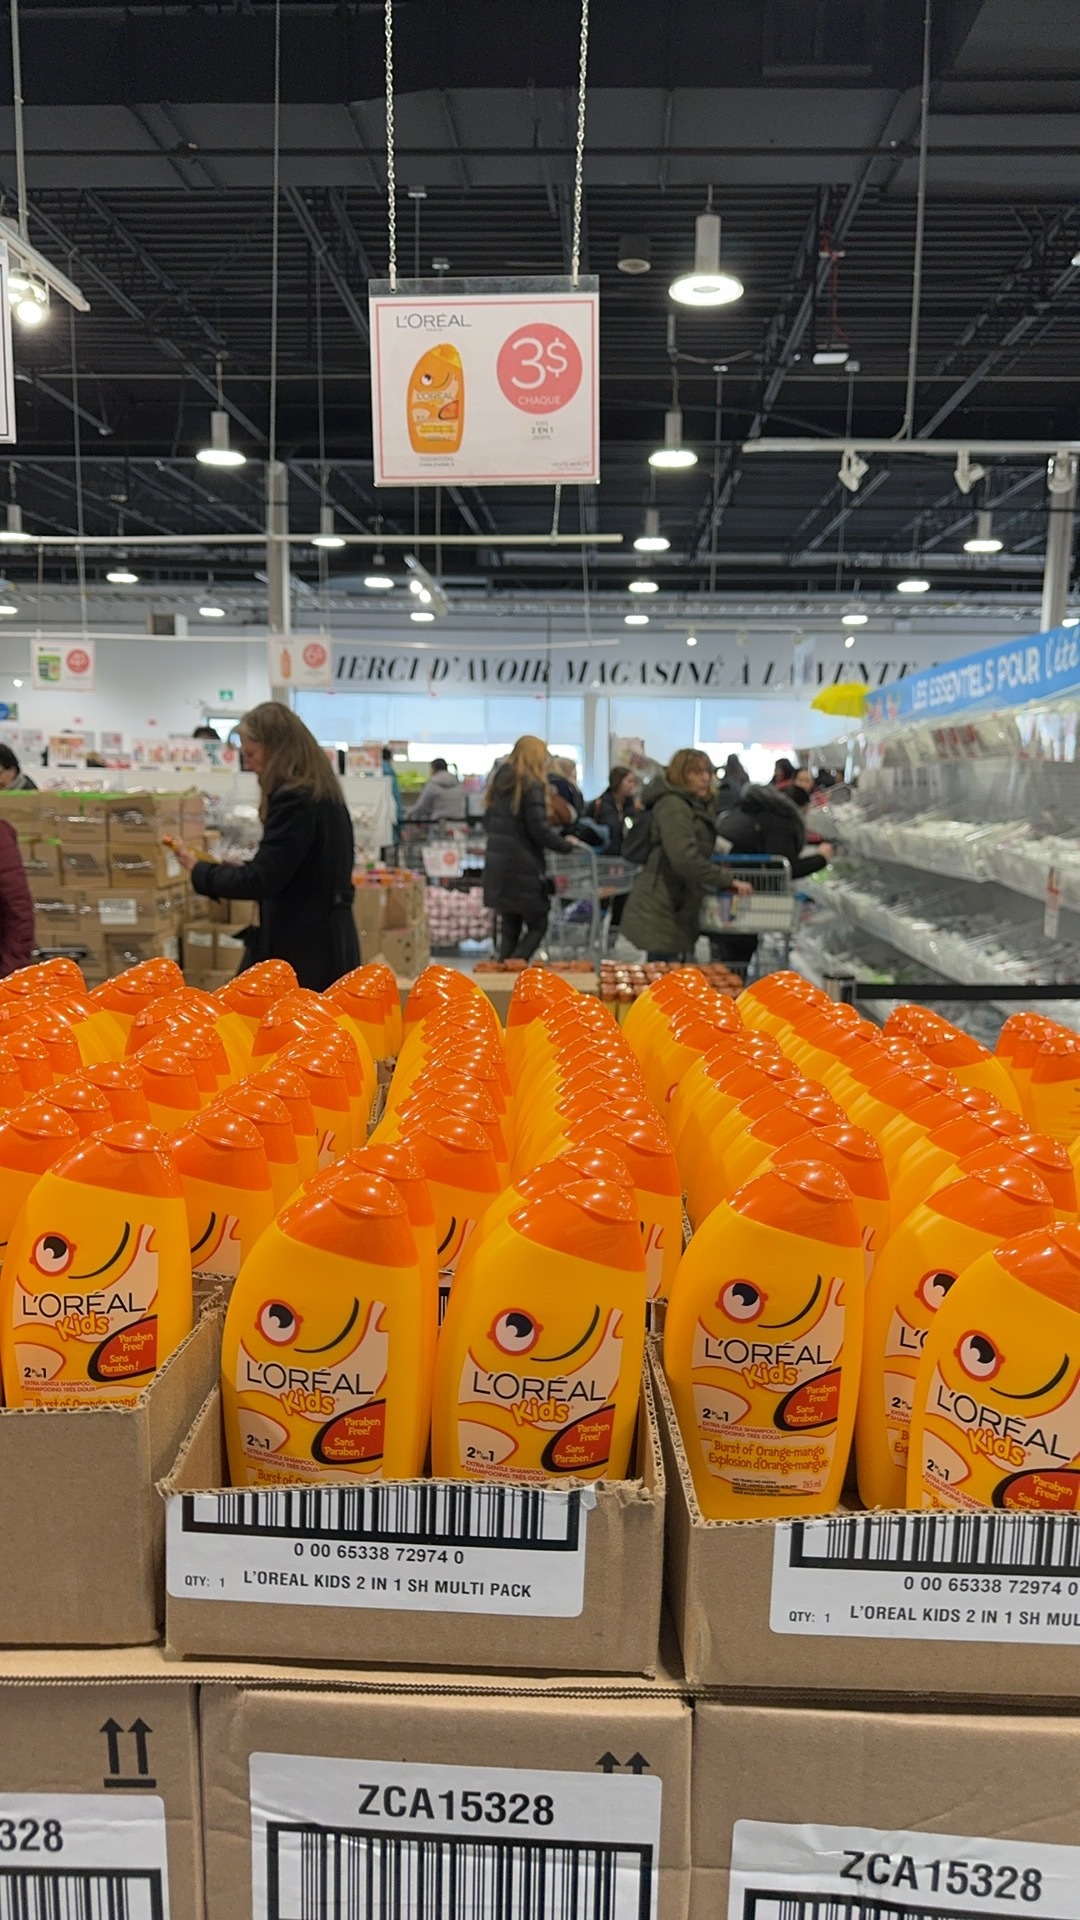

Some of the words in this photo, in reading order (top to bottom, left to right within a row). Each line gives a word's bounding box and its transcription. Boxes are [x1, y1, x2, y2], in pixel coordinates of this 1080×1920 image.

[396, 312, 472, 329] L'ORÉAL
[511, 337, 569, 390] 3$
[518, 395, 562, 406] CHAQUE
[335, 654, 420, 681] ERCI
[430, 655, 549, 683] D'AVOIR
[560, 653, 725, 686] MAGASINÉ
[731, 654, 750, 686] À
[911, 678, 928, 711] LES
[997, 646, 1041, 691] POUR
[23, 1292, 147, 1318] L'ORÉAL
[55, 1310, 110, 1343] Kids
[119, 1332, 153, 1343] Paraben
[123, 1341, 144, 1352] Free!
[705, 1338, 832, 1366] L'ORÉAL
[110, 1354, 129, 1363] Sans
[247, 1361, 374, 1395] L'ORÉAL
[742, 1360, 798, 1389] Kids
[473, 1371, 606, 1401] L'ORÉAL
[806, 1386, 837, 1394] Paraben
[280, 1388, 335, 1416] Kids
[809, 1394, 829, 1403] Free!
[511, 1397, 570, 1427] Kids
[796, 1406, 815, 1414] Sans
[344, 1417, 381, 1426] Paraben
[577, 1423, 610, 1433] Paraben
[937, 1385, 1070, 1461] L'ORÉAL
[349, 1427, 370, 1436] Free!
[580, 1433, 601, 1442] Free!
[702, 1427, 745, 1438] SHAMPOOING
[334, 1438, 354, 1446] Sans
[566, 1445, 585, 1453] Sans
[967, 1428, 1026, 1467] Kids
[714, 1440, 740, 1454] Burst
[742, 1444, 754, 1455] of
[756, 1445, 825, 1461] Orange-mango
[284, 1455, 315, 1466] SHAMPOO
[466, 1460, 485, 1469] EXTRA
[485, 1464, 508, 1473] GENTLE
[510, 1467, 543, 1475] SHAMPOO
[708, 1453, 751, 1468] Explosion
[753, 1456, 829, 1474] d'Orange-mangue
[258, 1469, 281, 1483] Burst
[282, 1474, 294, 1484] of
[300, 1465, 320, 1473] DOUX
[466, 1467, 510, 1479] SHAMPOOING
[802, 1480, 813, 1489] 265
[1032, 1475, 1073, 1495] Paraben
[1018, 1492, 1040, 1507] Sans
[1035, 1485, 1060, 1501] Free!
[294, 1543, 304, 1556] 0
[310, 1544, 331, 1557] 00
[337, 1545, 389, 1560] 65338
[395, 1548, 448, 1563] 72974
[454, 1551, 464, 1564] 0
[185, 1575, 210, 1587] QTY:
[219, 1577, 225, 1587] 1
[243, 1570, 309, 1587] L'OREAL
[314, 1574, 351, 1589] KIDS
[356, 1577, 365, 1589] 2
[371, 1577, 387, 1590] IN
[394, 1578, 401, 1591] 1
[407, 1579, 428, 1592] SH
[435, 1580, 484, 1595] MULTI
[490, 1583, 532, 1598] PACK
[904, 1576, 914, 1590] 0
[920, 1577, 942, 1591] 00
[948, 1578, 1002, 1593] 65338
[1008, 1580, 1062, 1595] 72974
[1068, 1581, 1078, 1596] 0
[789, 1611, 815, 1623] QTY:
[825, 1613, 830, 1623] 1
[850, 1605, 917, 1621] L'OREAL
[922, 1607, 961, 1623] KIDS
[966, 1609, 975, 1623] 2
[981, 1610, 998, 1624] IN
[1005, 1611, 1012, 1624] 1
[1019, 1611, 1040, 1625] SH
[358, 1784, 554, 1825] ZCA15328
[839, 1849, 1042, 1902] ZCA15328
